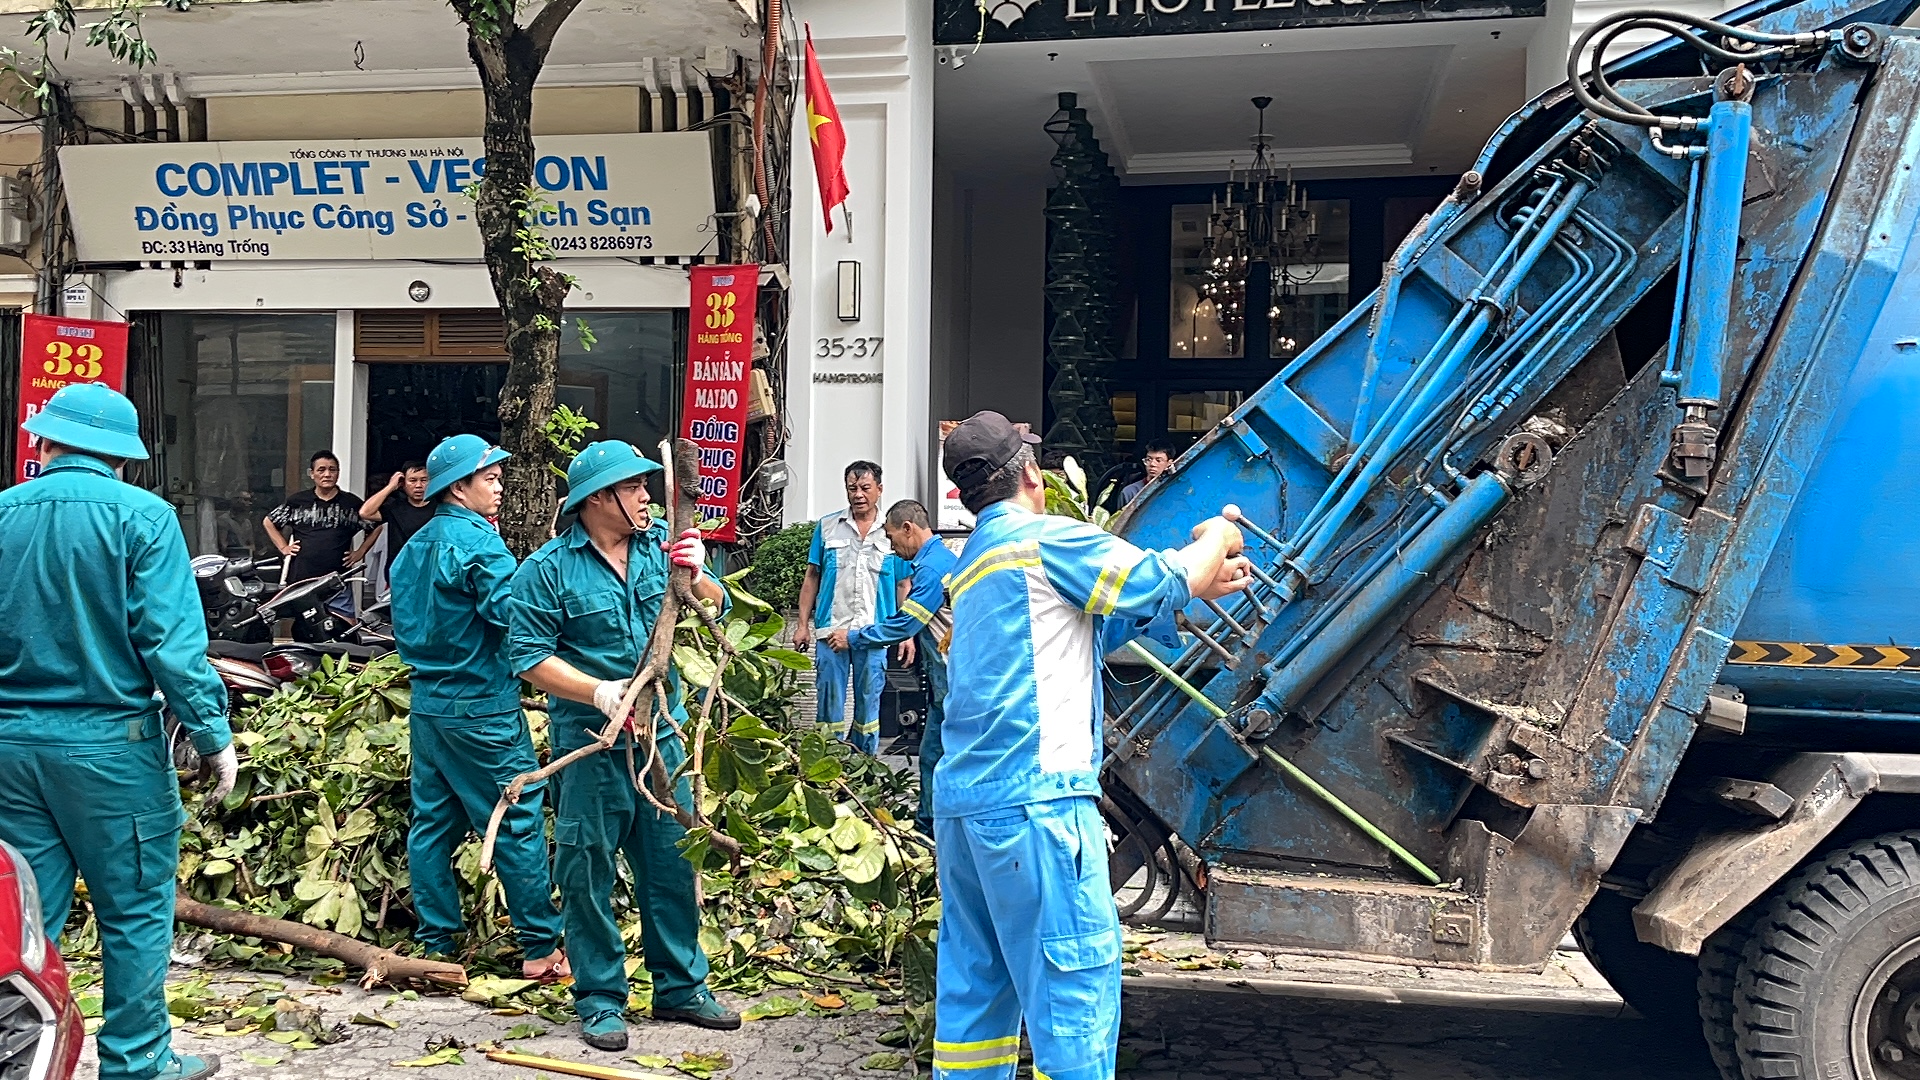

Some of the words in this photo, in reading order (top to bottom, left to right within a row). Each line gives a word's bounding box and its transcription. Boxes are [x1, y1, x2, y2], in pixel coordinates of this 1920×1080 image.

[318, 148, 346, 159] CÔNG
[349, 150, 363, 158] TY
[410, 149, 428, 159] MẠI
[430, 146, 445, 157] HÀ
[447, 146, 464, 158] NỘI
[155, 160, 370, 198] COMPLET
[134, 202, 219, 237] Đồng
[227, 203, 305, 236] Phục
[312, 202, 395, 236] Công
[406, 199, 449, 229] Sở
[587, 199, 652, 232] Sạn
[187, 239, 224, 256] Hàng
[228, 237, 270, 257] Trống
[551, 236, 587, 251] 0243
[590, 235, 653, 251] 8286973
[705, 291, 737, 330] 33
[43, 340, 105, 379] 33
[816, 336, 884, 359] 35-37
[690, 415, 739, 443] ĐỒNG
